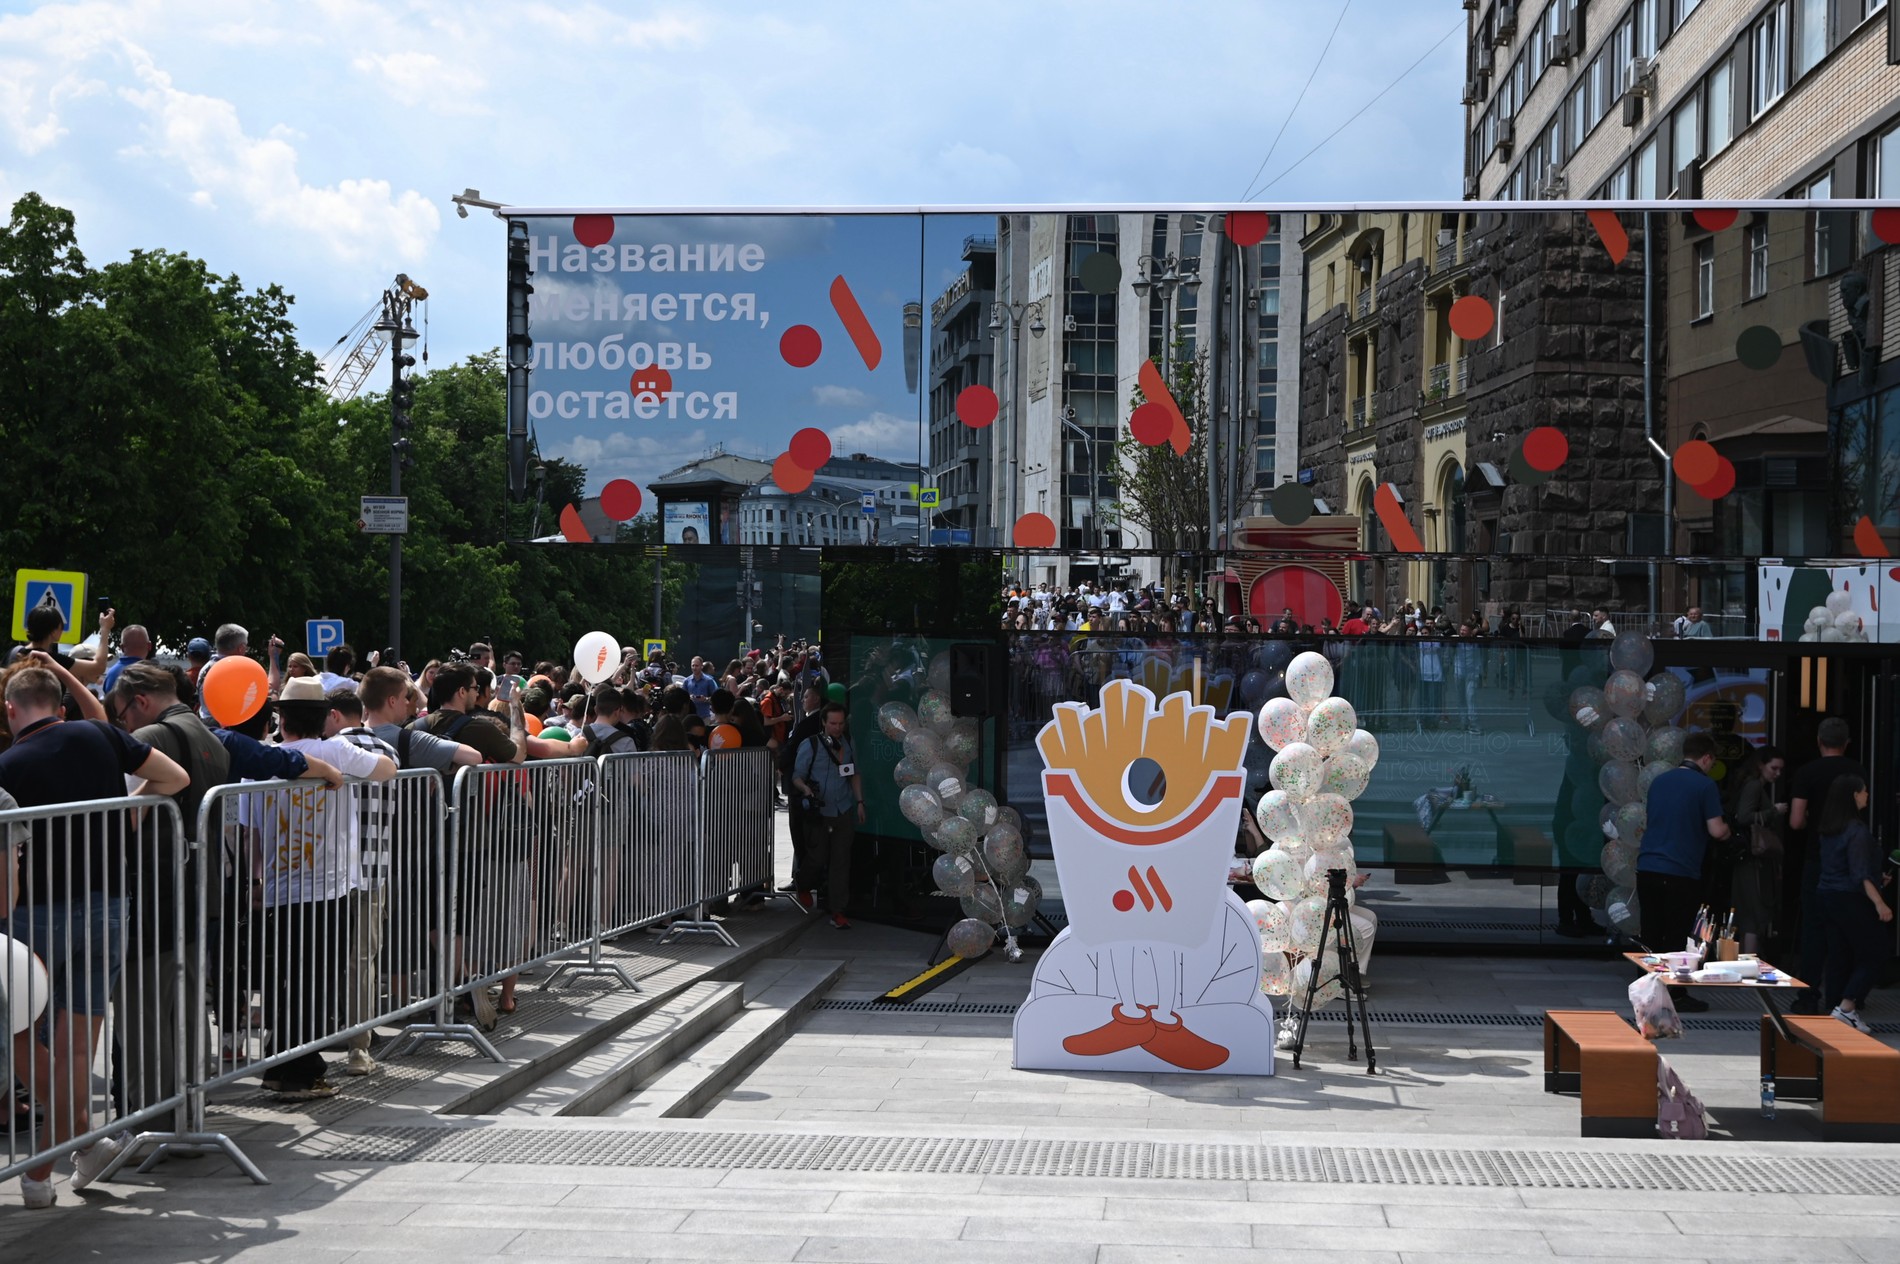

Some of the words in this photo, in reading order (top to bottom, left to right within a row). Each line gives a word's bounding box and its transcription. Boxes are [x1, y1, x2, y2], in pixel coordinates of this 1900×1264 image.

[529, 235, 765, 273] Название
[529, 292, 770, 328] меняется,
[529, 333, 712, 371] любовь
[528, 381, 738, 420] остаётся
[316, 624, 337, 653] P
